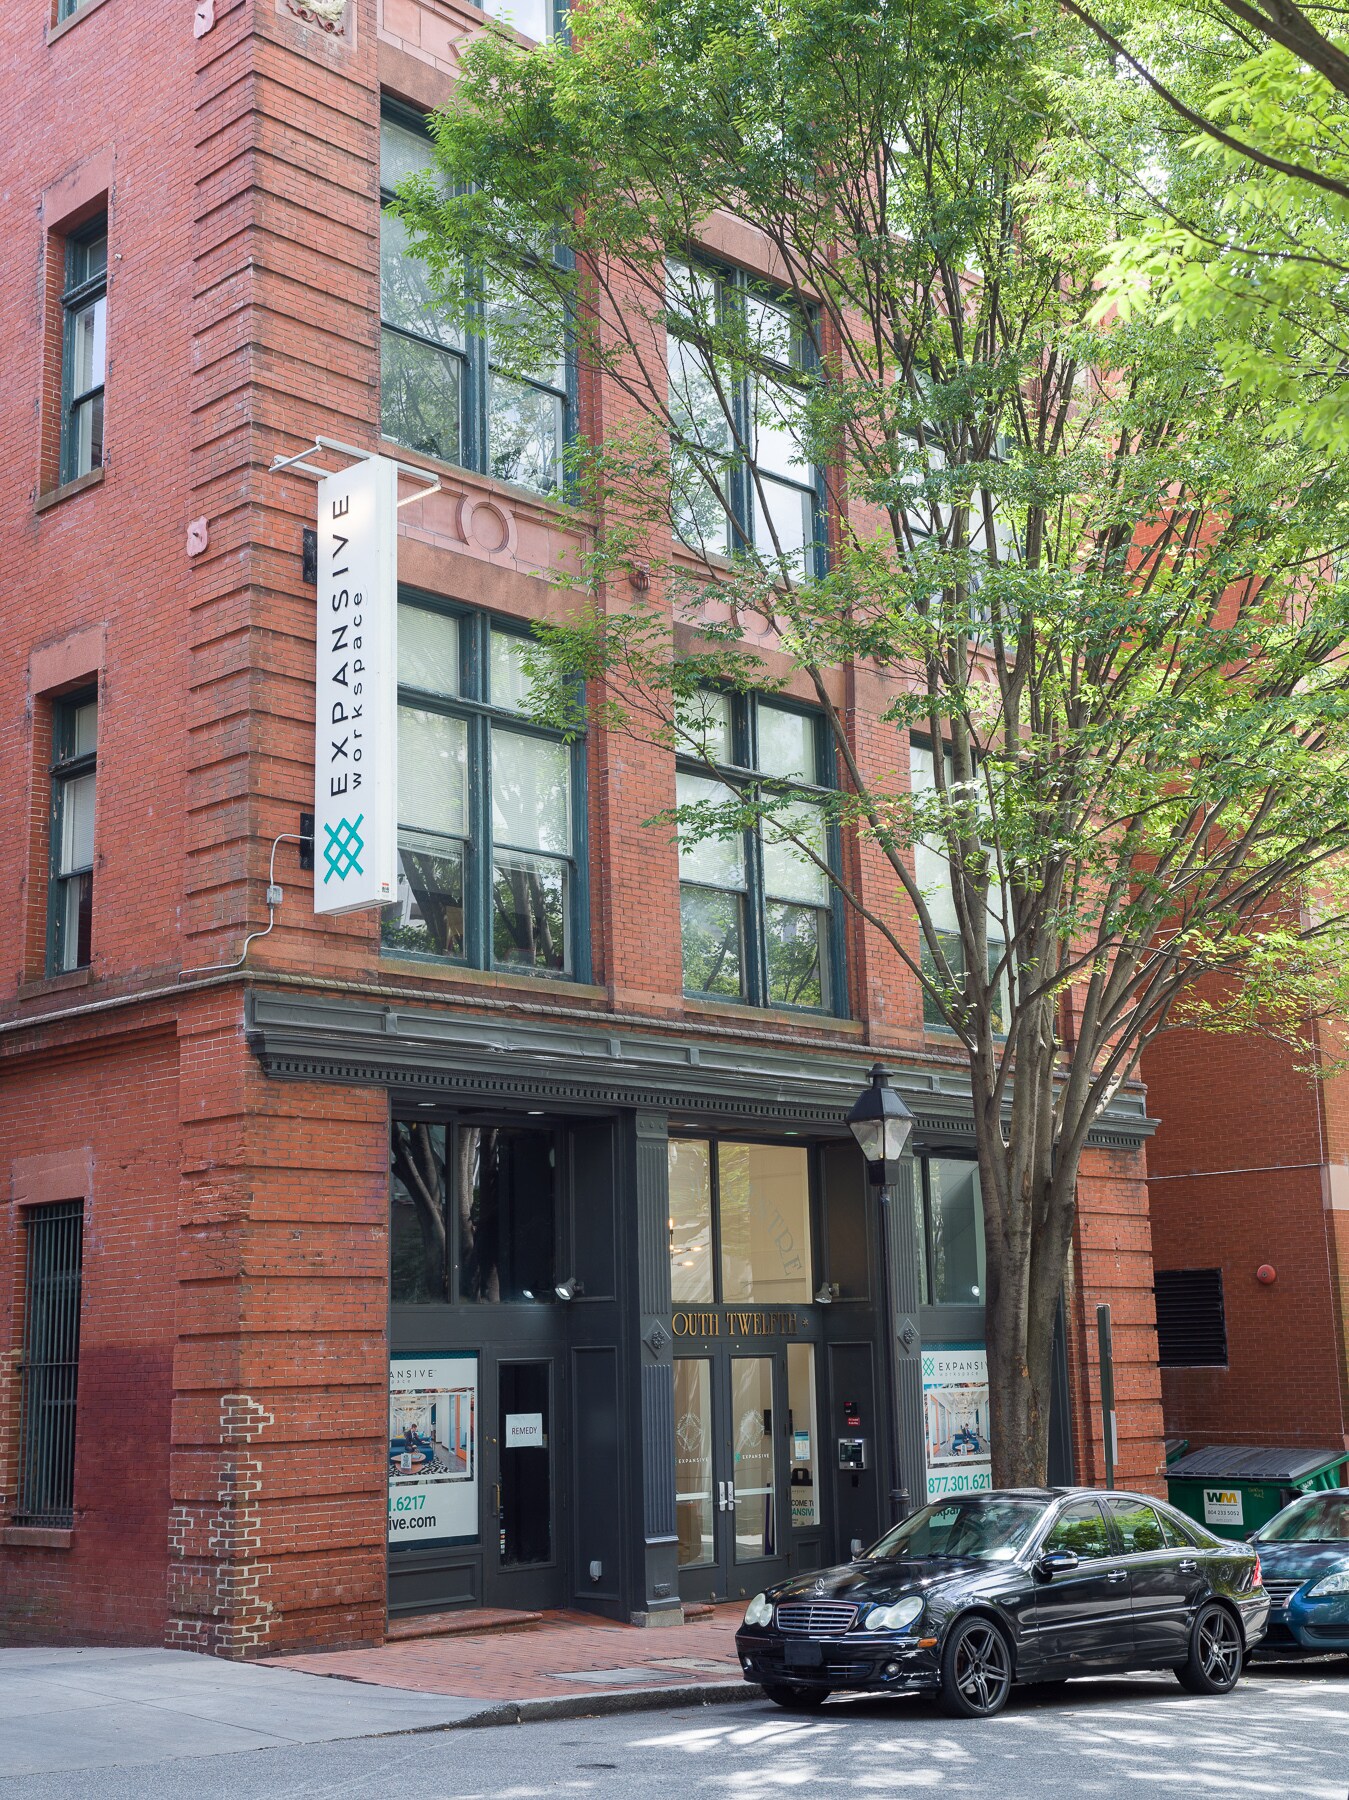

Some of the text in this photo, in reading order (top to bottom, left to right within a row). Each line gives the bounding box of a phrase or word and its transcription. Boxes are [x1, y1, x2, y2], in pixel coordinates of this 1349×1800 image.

[330, 495, 349, 797] EXPANSIVE
[351, 592, 365, 790] workspace
[672, 1312, 798, 1336] OUTH TWELFTH
[938, 1361, 987, 1371] EXPANSI
[511, 1426, 538, 1435] REMEDY
[928, 1473, 992, 1494] 877.301.621
[1207, 1492, 1237, 1503] WM
